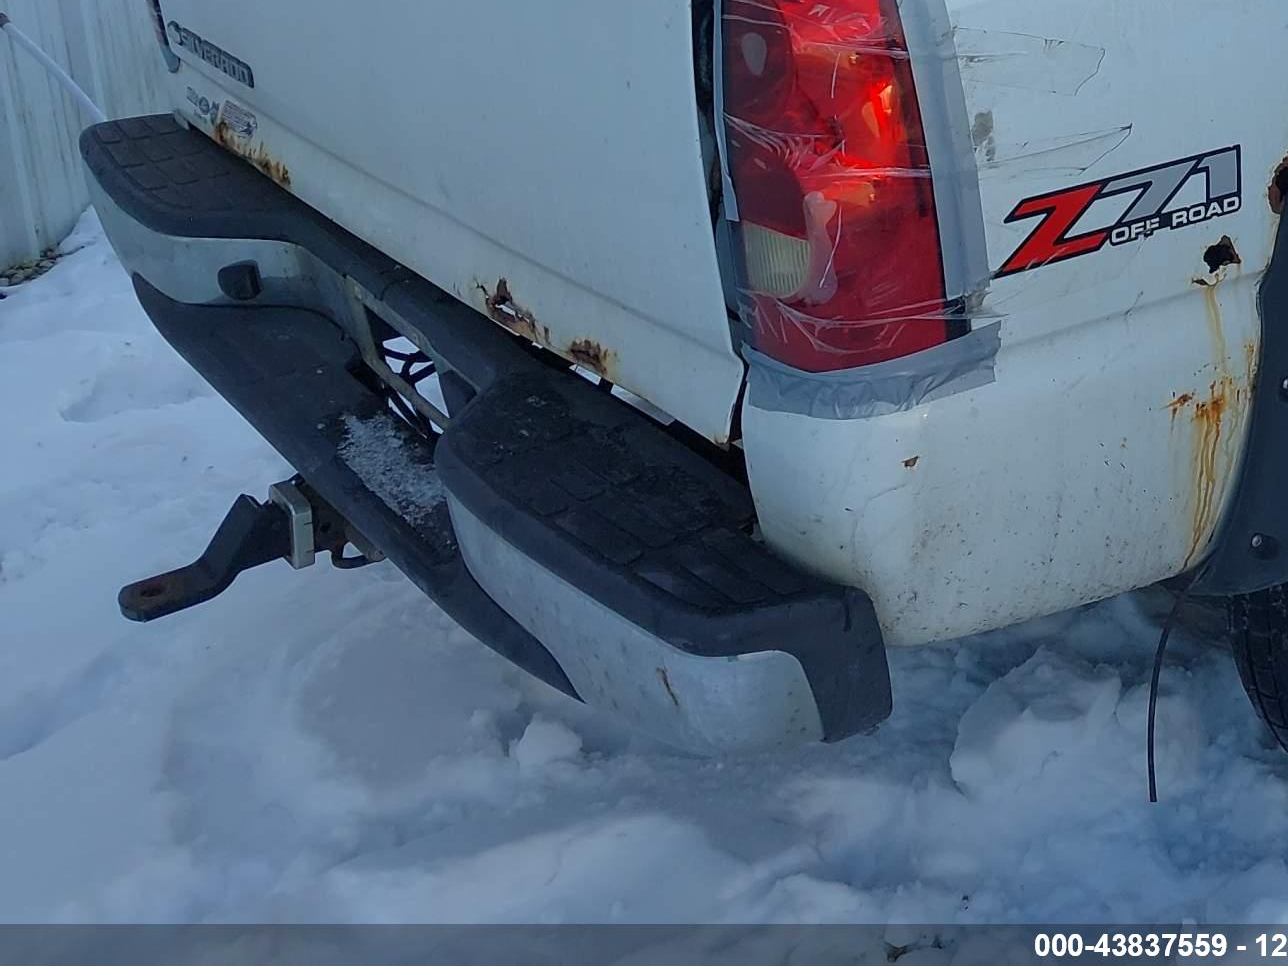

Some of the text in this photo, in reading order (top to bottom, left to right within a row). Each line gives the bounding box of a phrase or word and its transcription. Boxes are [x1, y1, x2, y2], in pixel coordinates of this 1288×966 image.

[988, 143, 1242, 280] Z71
[1110, 194, 1241, 246] OFF ROAD
